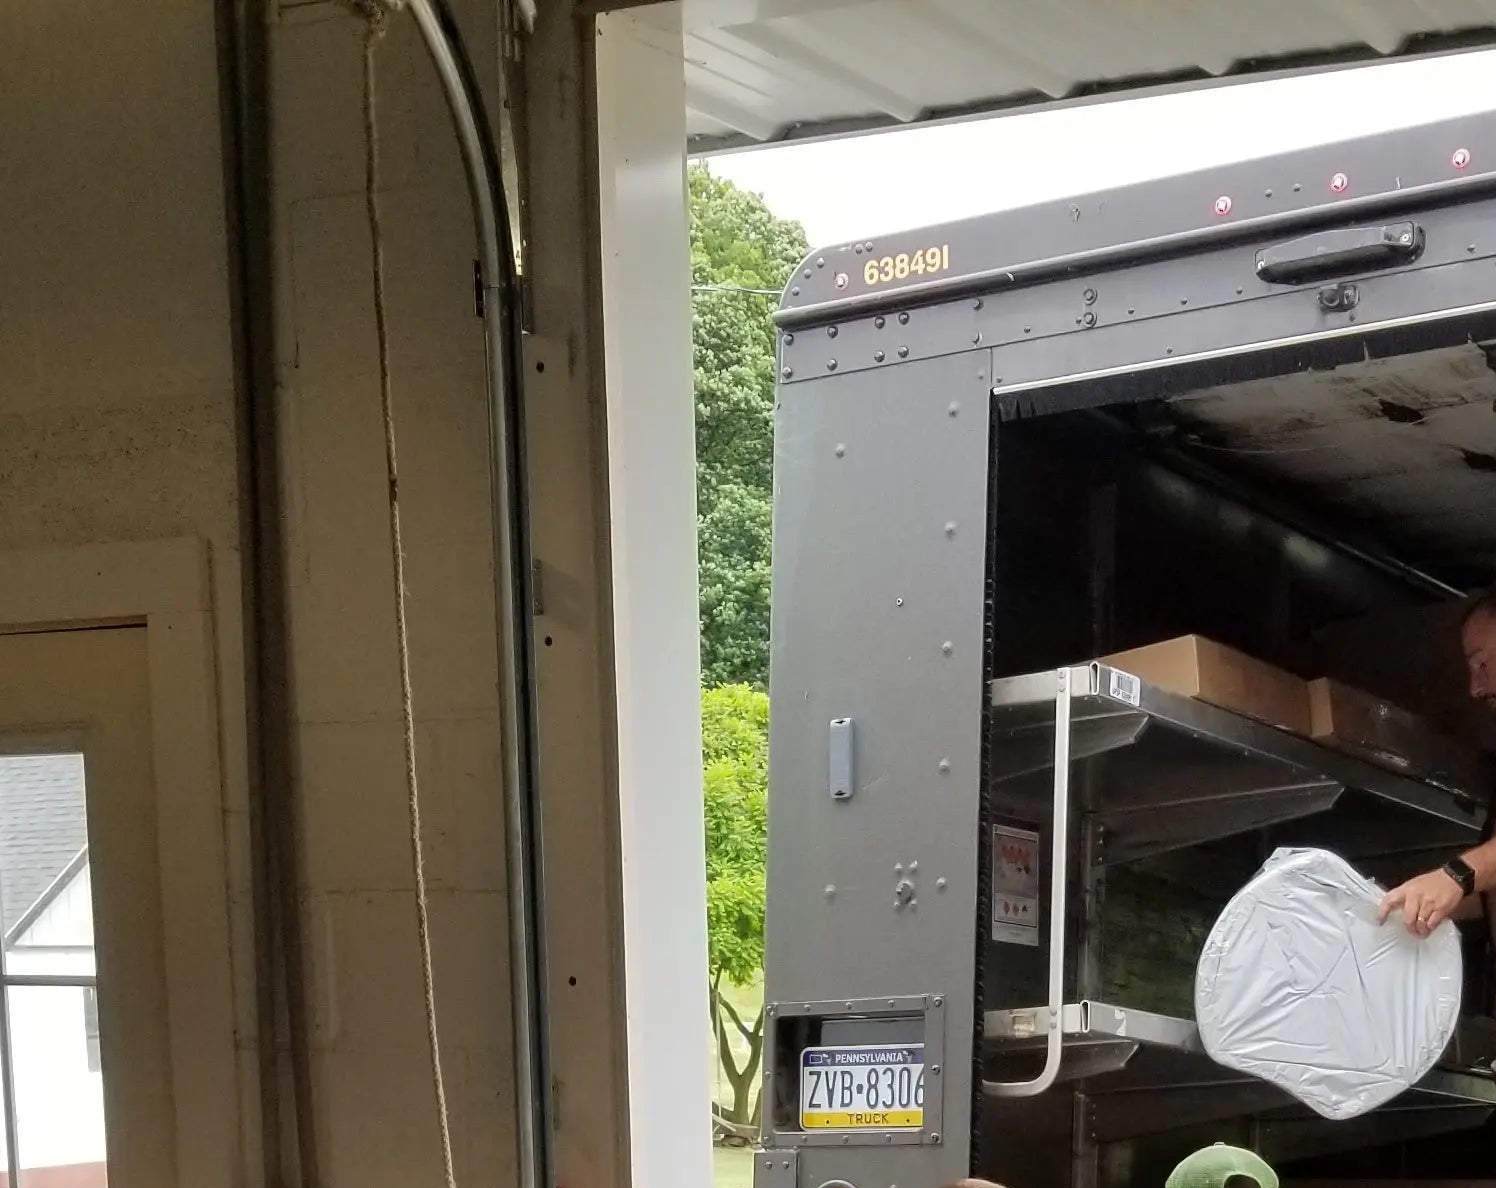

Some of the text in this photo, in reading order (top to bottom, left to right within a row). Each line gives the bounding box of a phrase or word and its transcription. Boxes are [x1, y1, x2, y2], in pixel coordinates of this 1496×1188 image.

[864, 245, 949, 285] 638491
[835, 1052, 903, 1064] PENNSYLVANIA
[847, 1113, 888, 1124] TRUCK
